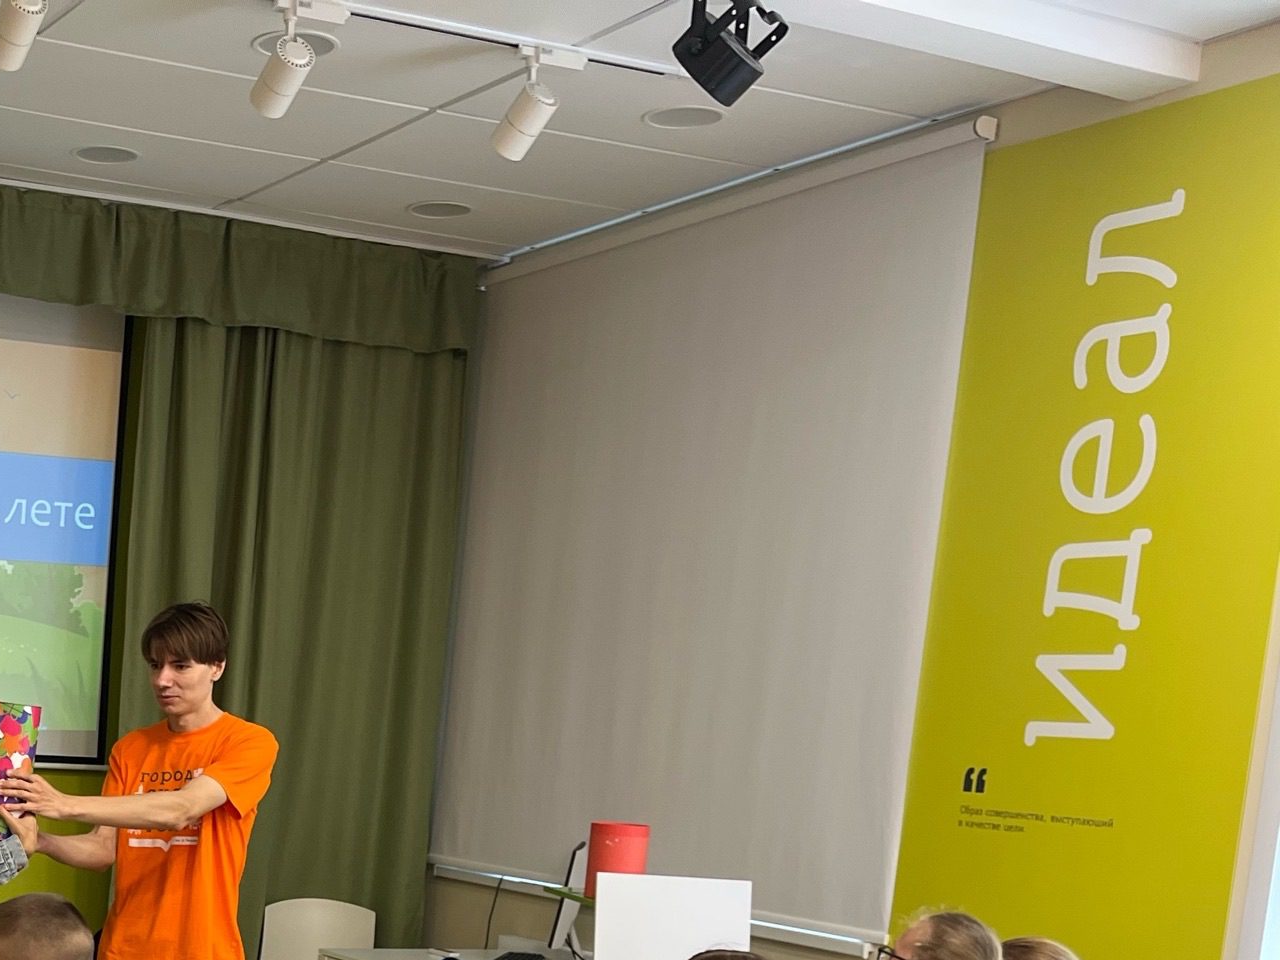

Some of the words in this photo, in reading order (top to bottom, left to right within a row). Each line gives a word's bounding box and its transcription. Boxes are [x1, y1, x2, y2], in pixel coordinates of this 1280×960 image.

[1024, 188, 1186, 746] идеал
[4, 496, 97, 533] лете
[140, 770, 193, 785] город
[960, 805, 983, 816] Образ
[1050, 816, 1114, 828] выступающий
[965, 820, 1002, 831] качестве
